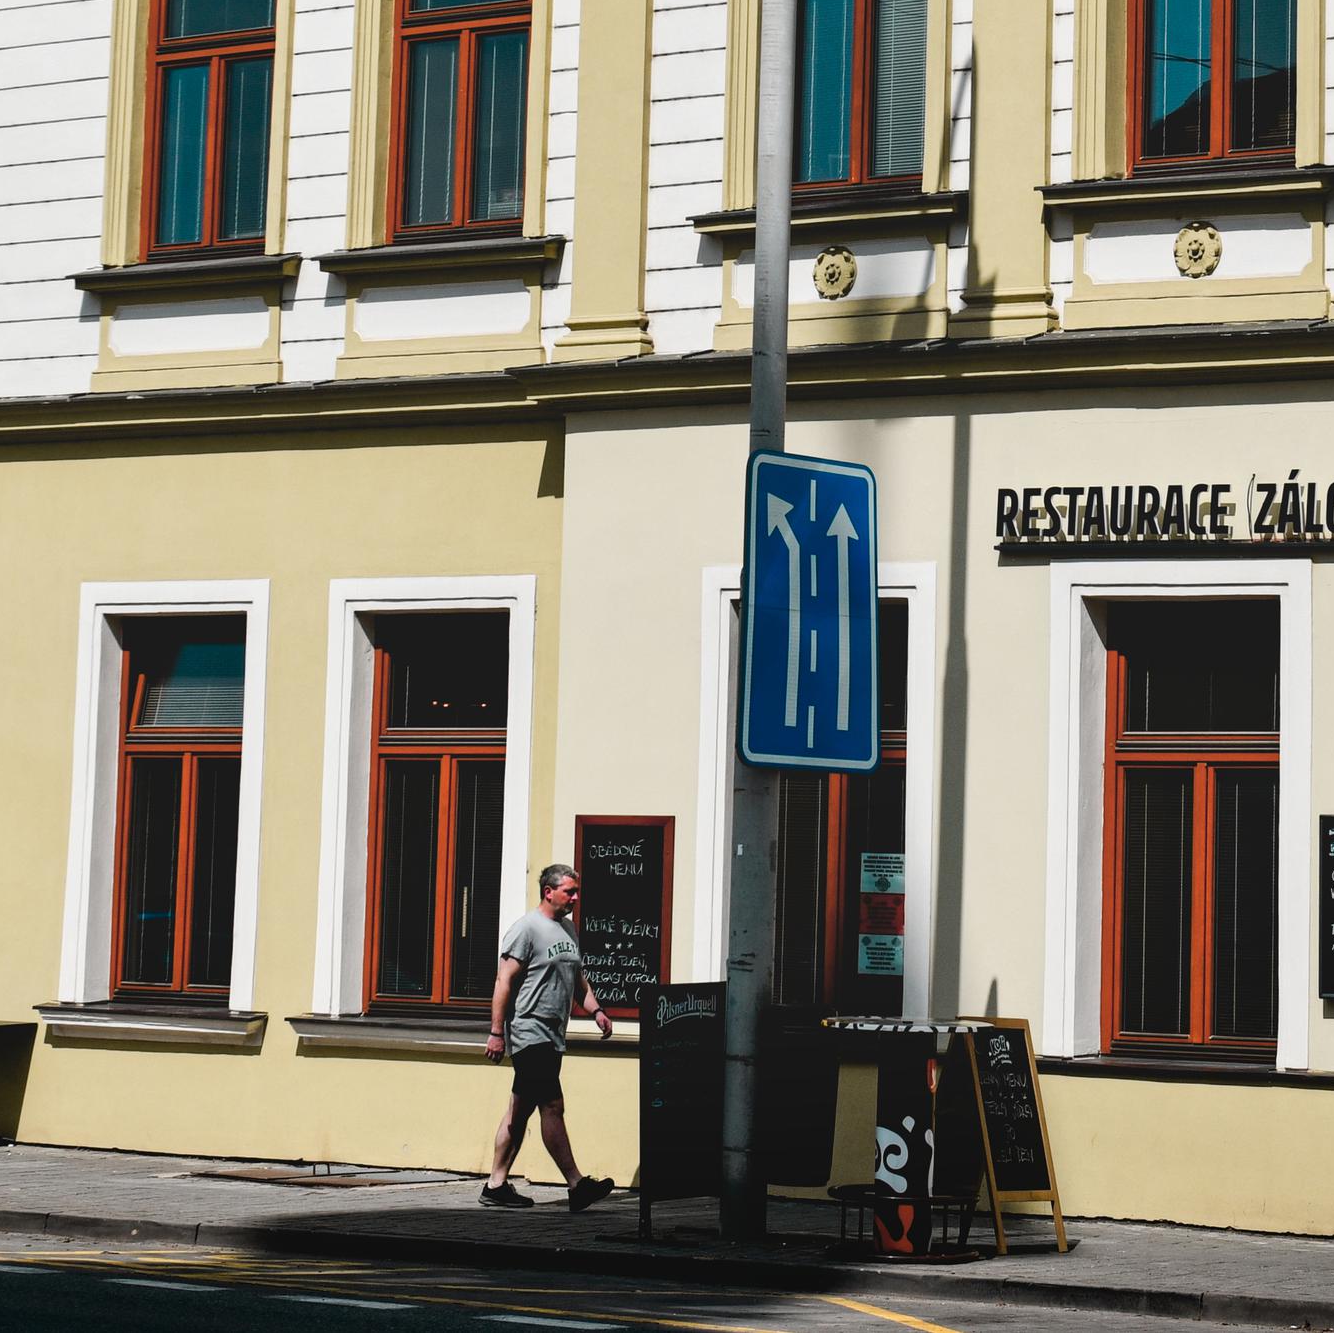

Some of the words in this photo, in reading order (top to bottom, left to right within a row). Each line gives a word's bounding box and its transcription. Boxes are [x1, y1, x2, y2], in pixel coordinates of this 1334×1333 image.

[995, 482, 1232, 538] RESTAURACE
[589, 838, 645, 859] OBĚDOVÉ
[609, 862, 644, 876] MENU
[656, 994, 688, 1028] Pilsner
[687, 993, 717, 1019] Urquell
